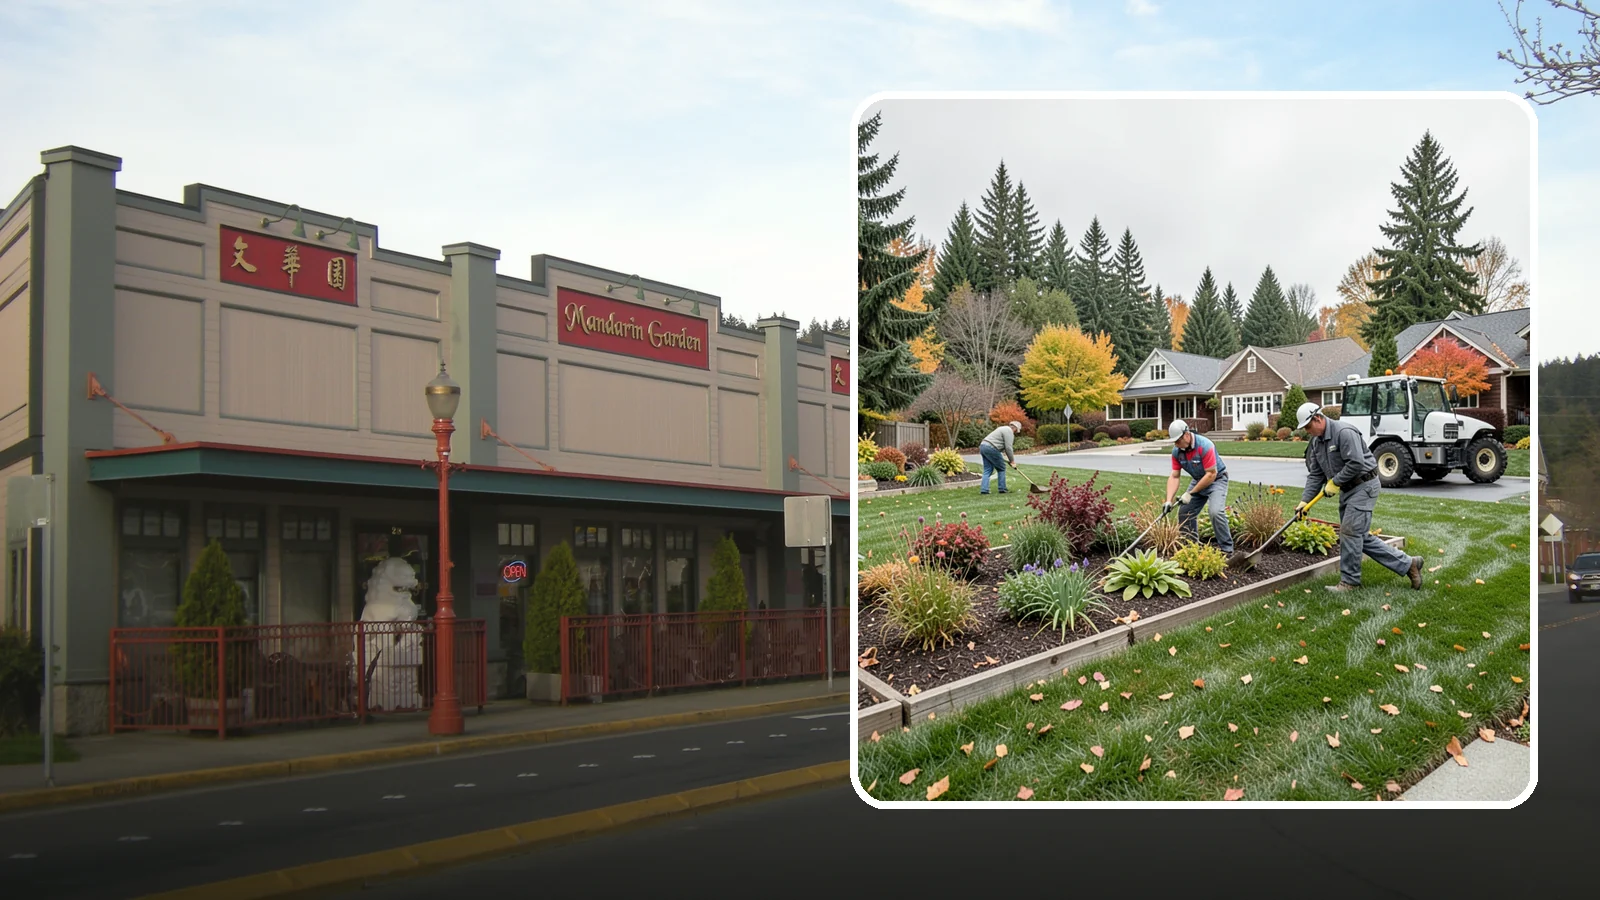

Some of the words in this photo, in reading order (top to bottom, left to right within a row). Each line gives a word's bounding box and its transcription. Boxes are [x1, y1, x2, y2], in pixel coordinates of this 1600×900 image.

[230, 235, 346, 291] 文華園
[564, 302, 644, 341] Mandarin
[647, 320, 702, 352] Garden
[503, 565, 527, 578] OPEN
